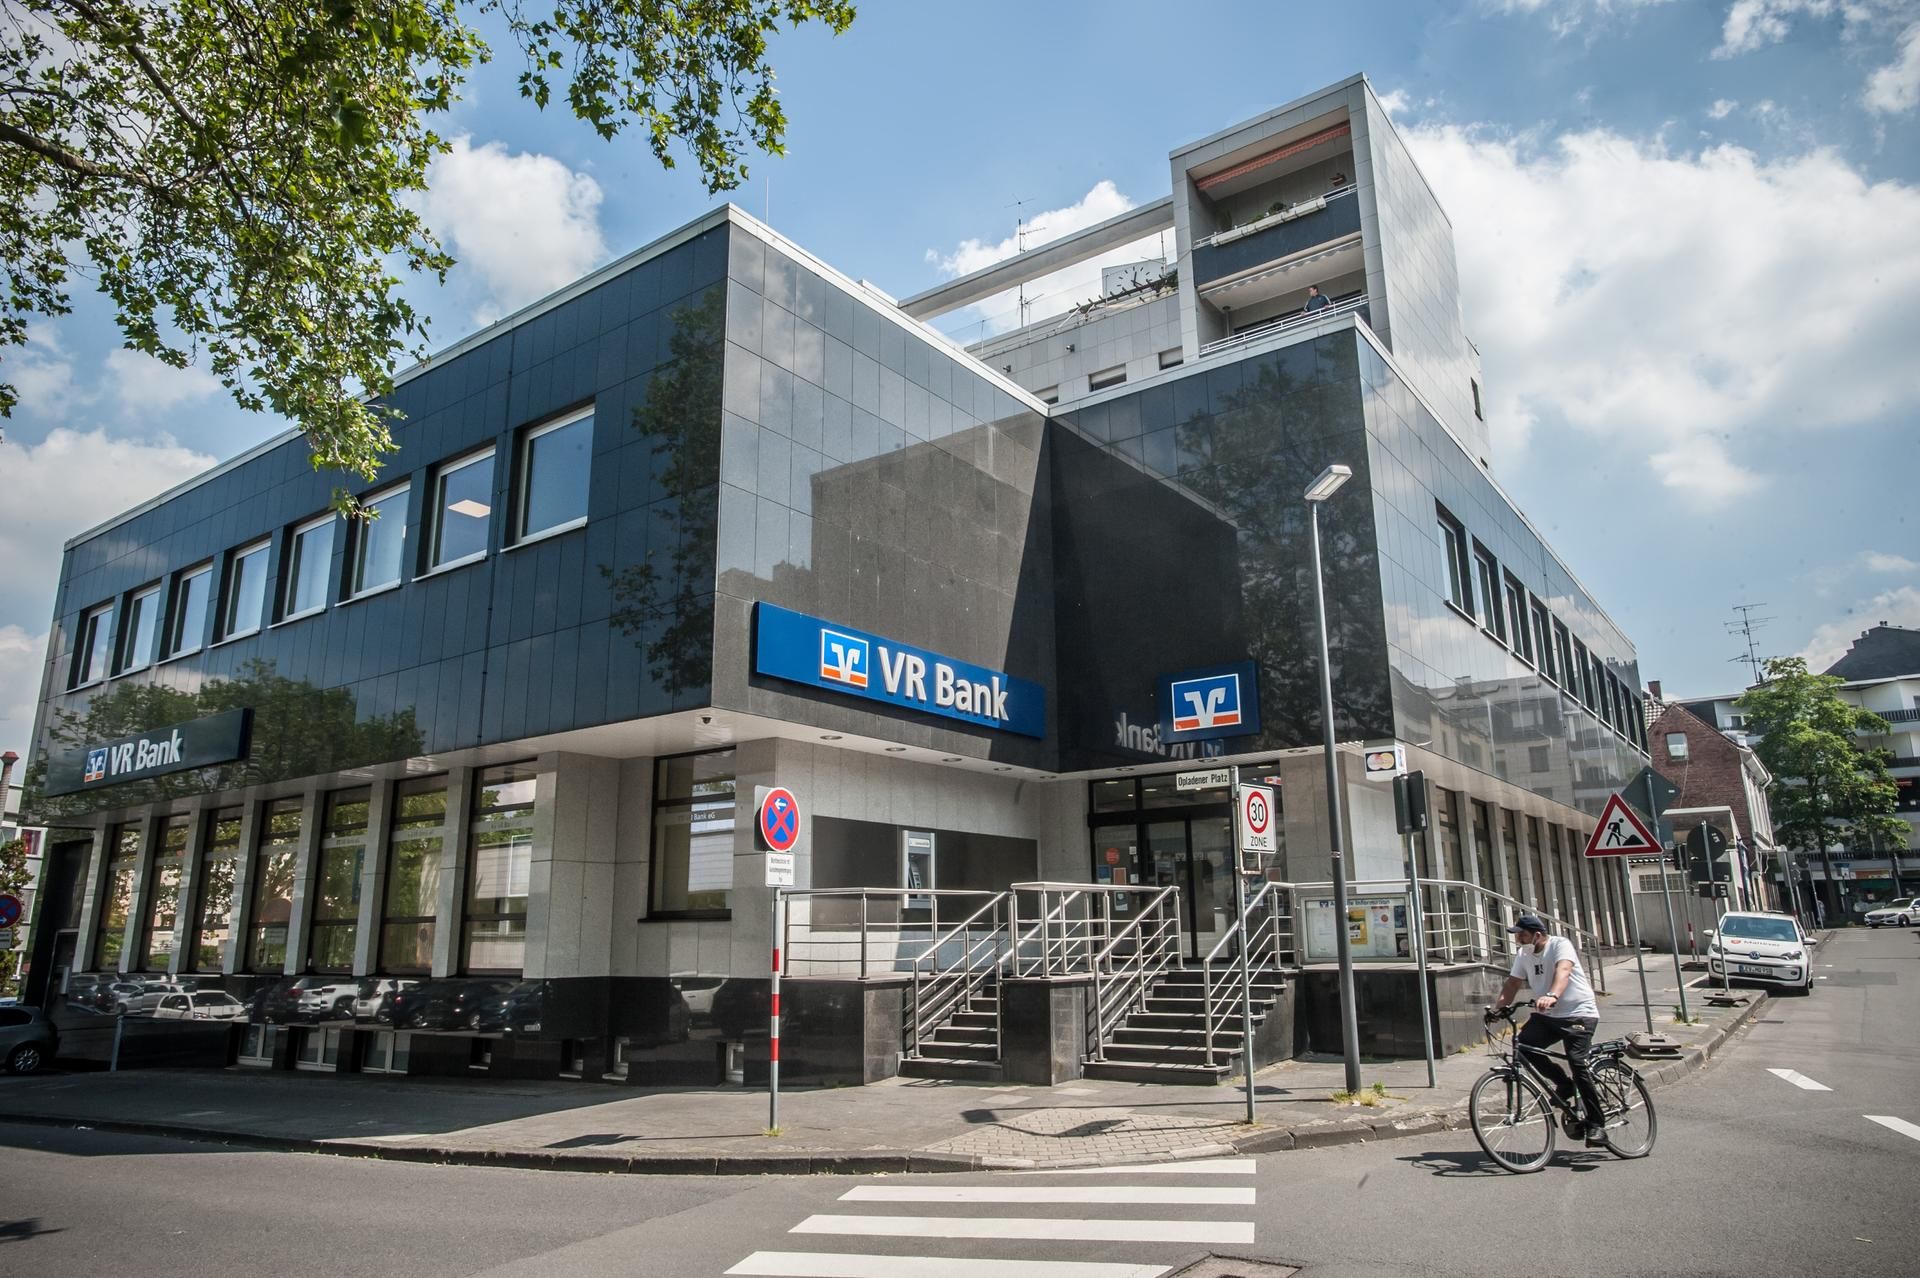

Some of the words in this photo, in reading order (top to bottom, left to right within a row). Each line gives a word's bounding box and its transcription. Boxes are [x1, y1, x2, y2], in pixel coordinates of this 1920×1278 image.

[878, 647, 927, 701] VR
[934, 663, 1010, 721] Bank
[111, 743, 135, 775] VR
[135, 729, 183, 770] Bank
[1178, 776, 1208, 787] Opladener
[1210, 773, 1228, 784] Platz
[1251, 803, 1264, 822] 30
[1250, 836, 1267, 847] ZONE
